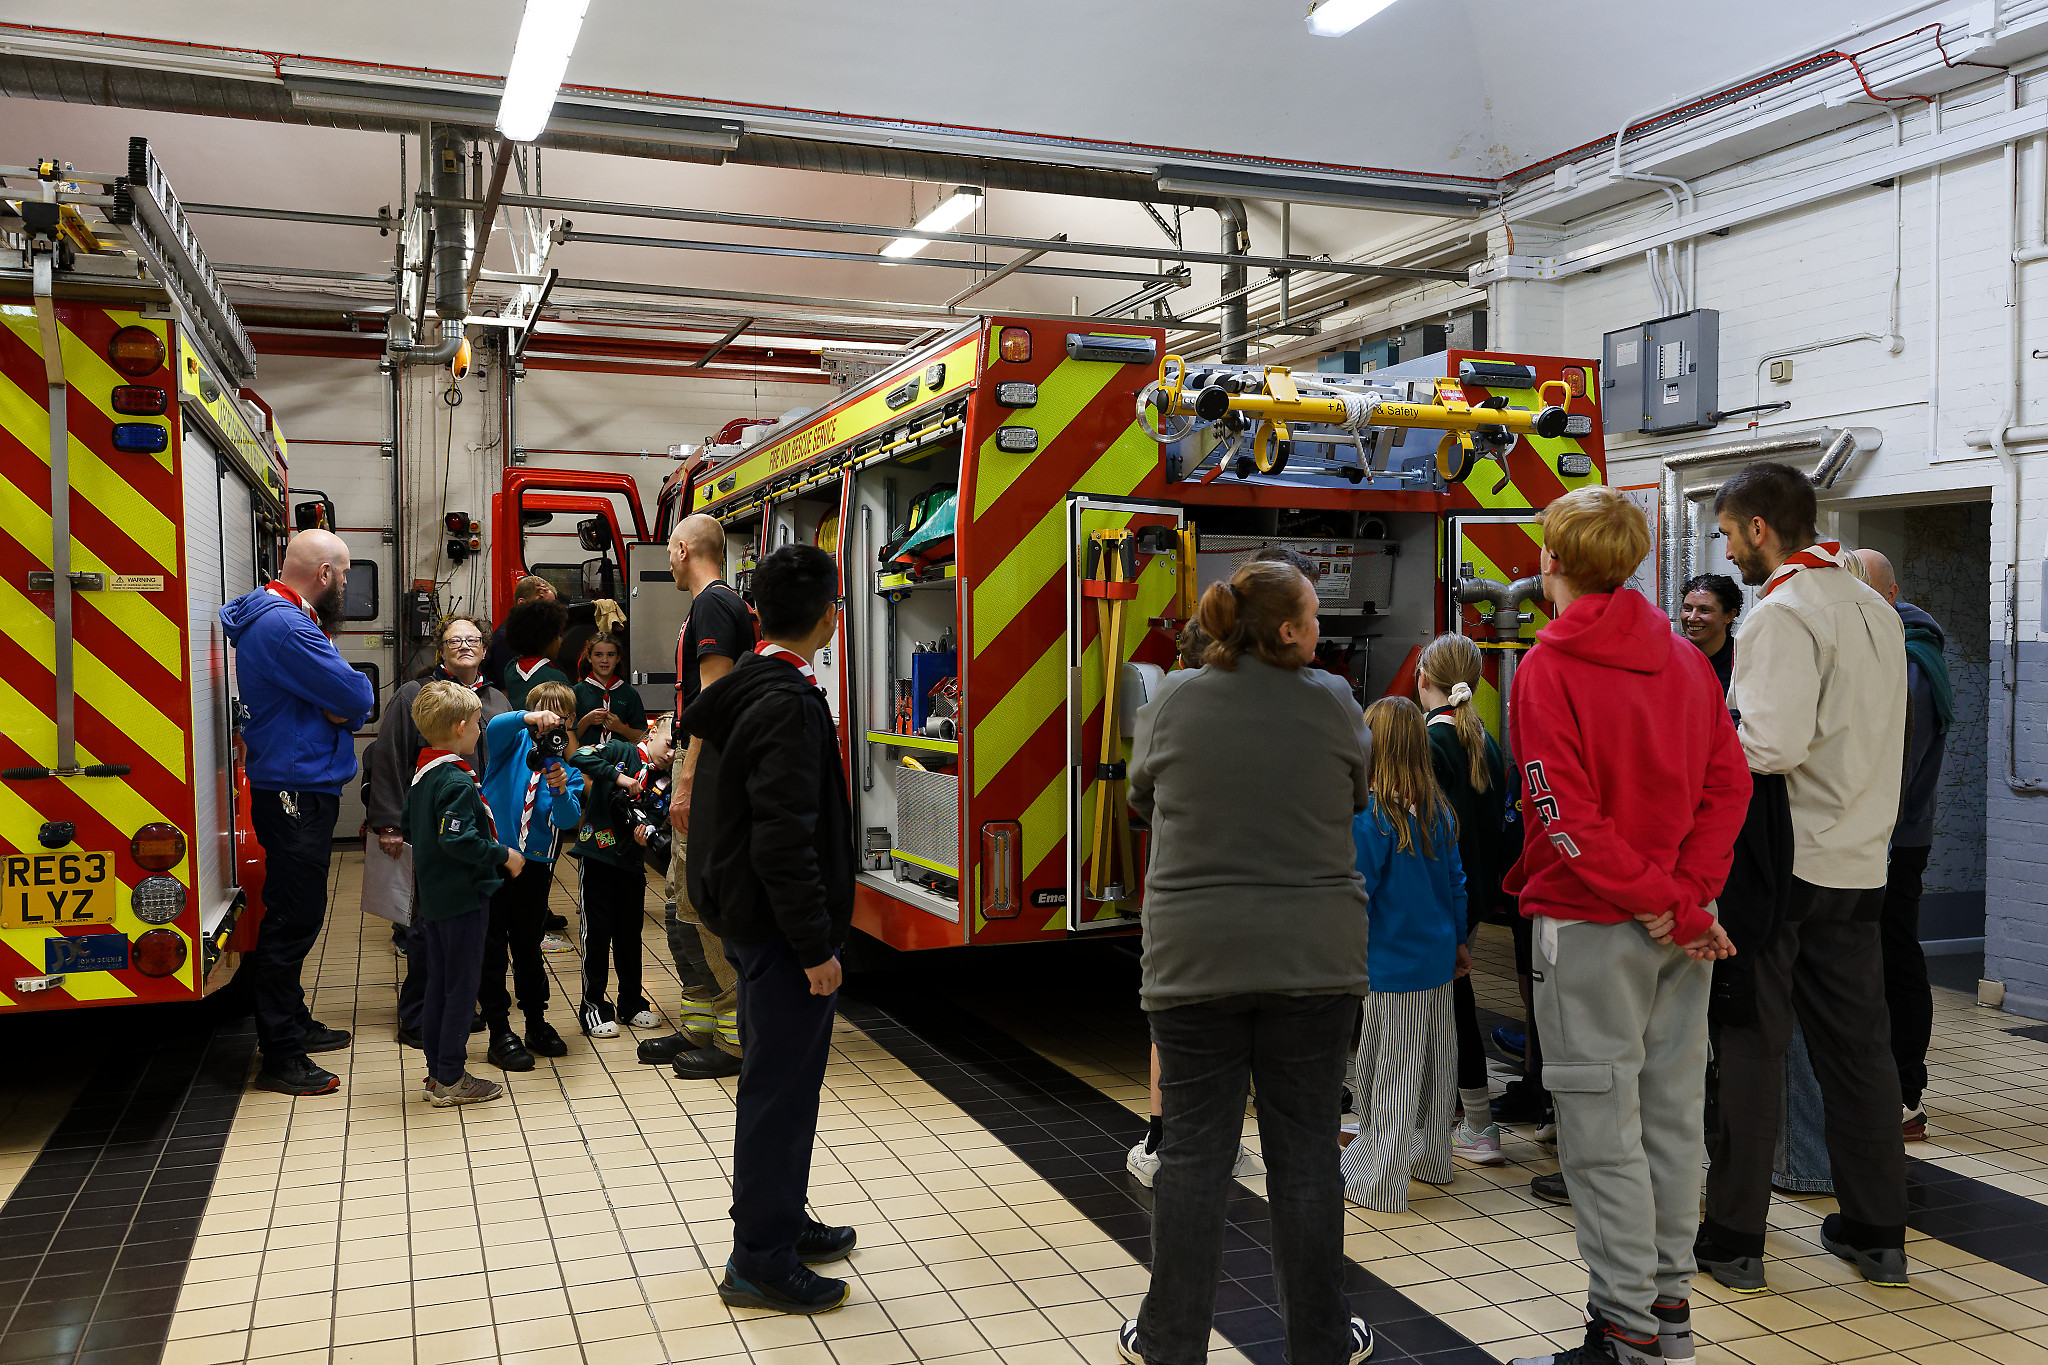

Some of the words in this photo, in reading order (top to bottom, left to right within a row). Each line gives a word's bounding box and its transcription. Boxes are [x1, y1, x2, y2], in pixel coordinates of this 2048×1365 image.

[1376, 405, 1384, 414] &
[1387, 405, 1419, 419] Safety
[780, 443, 790, 467] AND
[8, 854, 106, 887] RE63
[22, 889, 93, 922] LYZ
